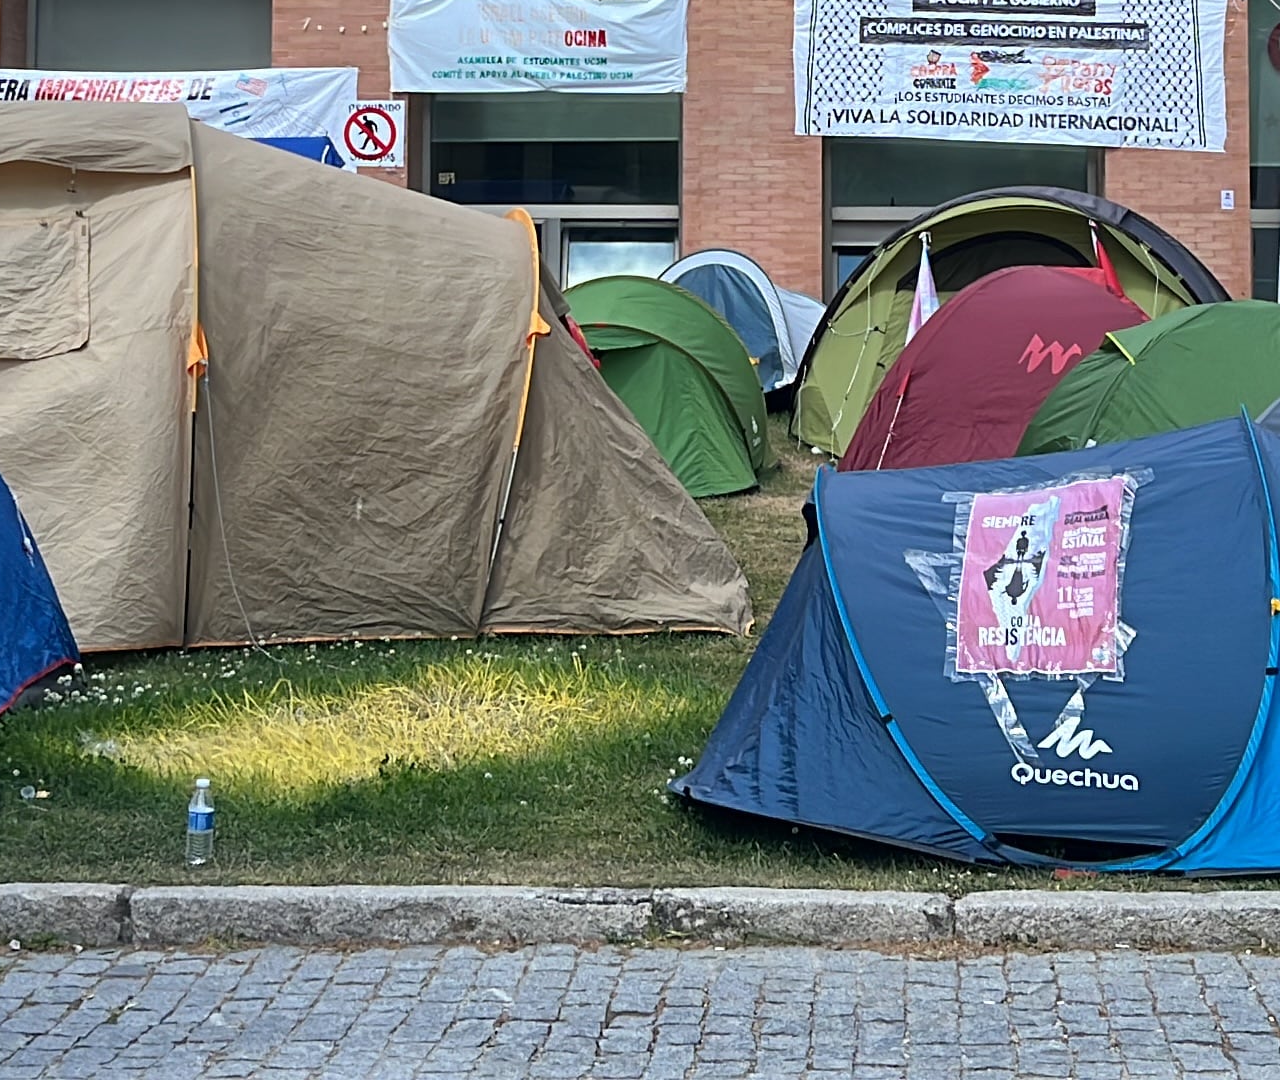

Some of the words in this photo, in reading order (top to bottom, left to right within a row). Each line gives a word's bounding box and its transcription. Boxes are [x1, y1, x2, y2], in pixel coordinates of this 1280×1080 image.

[863, 20, 942, 37] ¡CÓMPLICES
[944, 23, 968, 37] DEL
[970, 24, 1044, 39] GENOCIDIO
[1049, 26, 1066, 39] EN
[1069, 27, 1145, 41] PALESTINA!
[523, 56, 580, 66] ESTUDIANTES
[585, 57, 608, 66] UC3M
[431, 68, 463, 79] COMITÉ
[480, 70, 508, 79] APOYO
[187, 77, 215, 101] DE
[894, 92, 921, 104] ¡LOS
[925, 92, 1004, 105] ESTUDIANTES
[1008, 94, 1063, 107] DECIMOS
[1067, 96, 1111, 108] BASTA!
[827, 108, 875, 128] ¡VIVA
[880, 109, 900, 124] LA
[907, 110, 1024, 128] SOLIDARIDAD
[1029, 114, 1179, 132] INTERNACIONAL!
[981, 514, 1037, 529] SIEMPRE
[1062, 533, 1107, 549] ESTATAL
[1057, 585, 1073, 602] 11
[978, 626, 1067, 647] RESISTENCIA
[1010, 762, 1139, 791] Quechua
